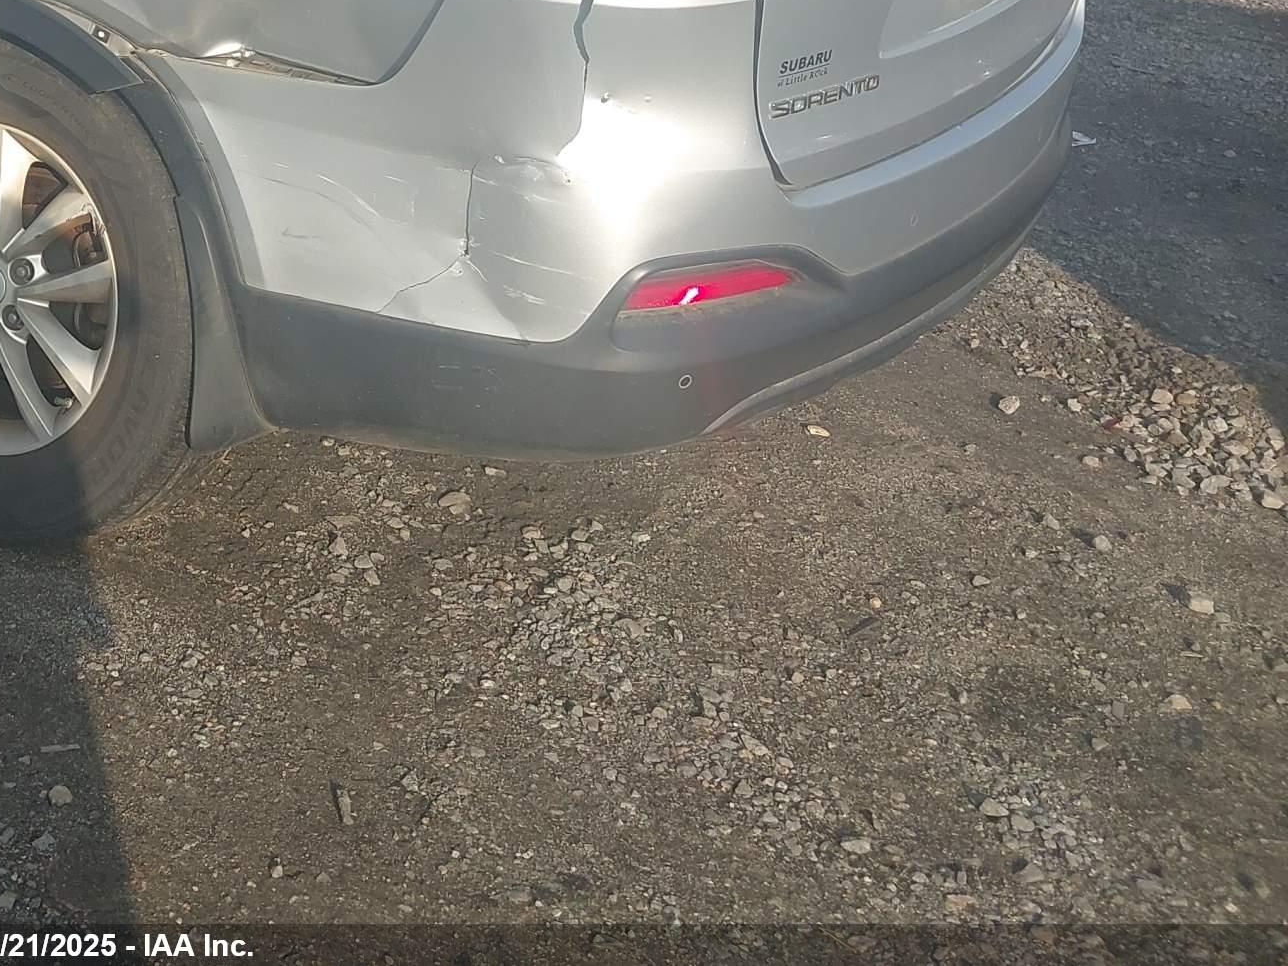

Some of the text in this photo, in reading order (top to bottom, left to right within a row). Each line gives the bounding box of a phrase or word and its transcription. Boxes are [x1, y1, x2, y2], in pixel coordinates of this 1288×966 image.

[779, 49, 833, 75] SUBARU
[785, 73, 808, 87] Little
[768, 74, 881, 120] SORENTO
